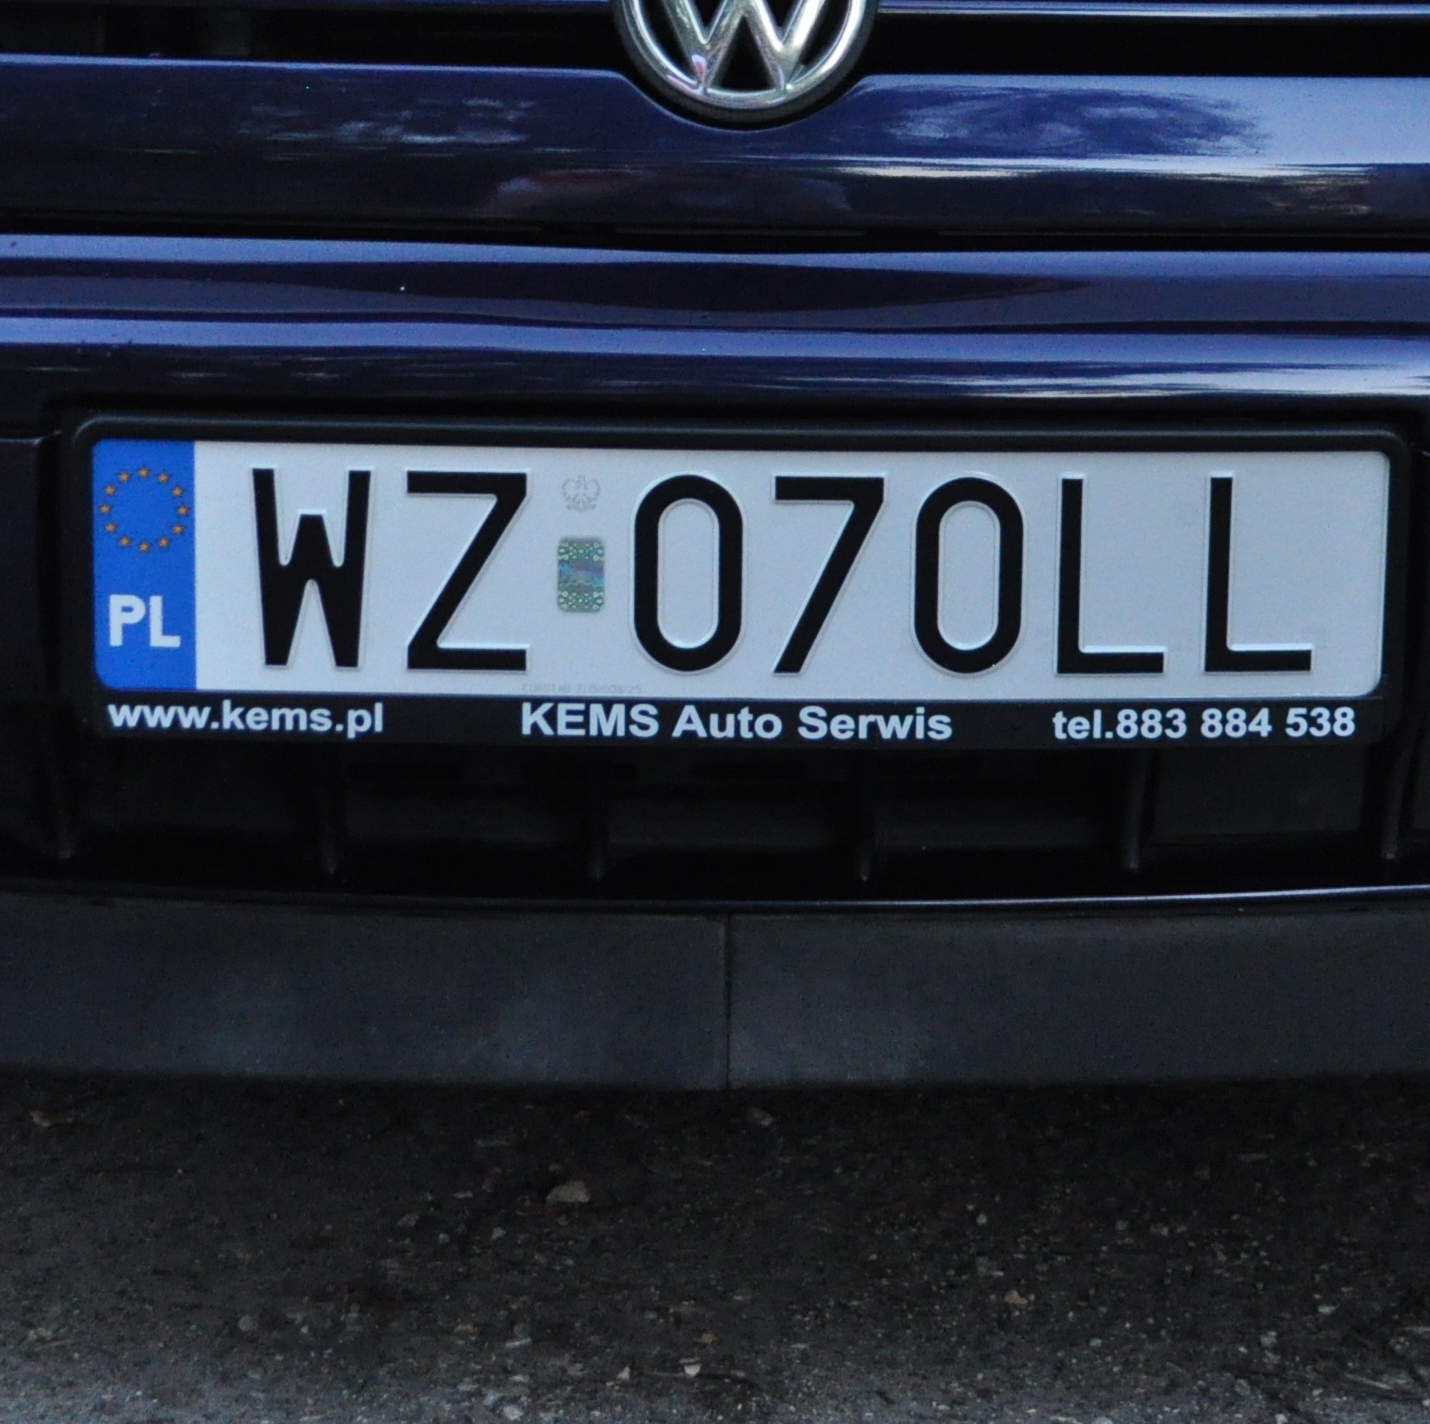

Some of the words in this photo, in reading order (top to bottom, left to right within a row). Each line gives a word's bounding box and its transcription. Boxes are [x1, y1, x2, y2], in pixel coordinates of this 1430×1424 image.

[251, 466, 528, 672] WZ
[631, 473, 1313, 675] 070LL
[107, 593, 182, 648] PL
[107, 698, 384, 740] www.kems.pl
[520, 700, 660, 739] KEMS
[670, 701, 785, 740] Auto
[797, 702, 954, 742] Serwis
[1051, 705, 1188, 741] tel.883
[1199, 705, 1274, 740] 884
[1284, 704, 1357, 739] 538
